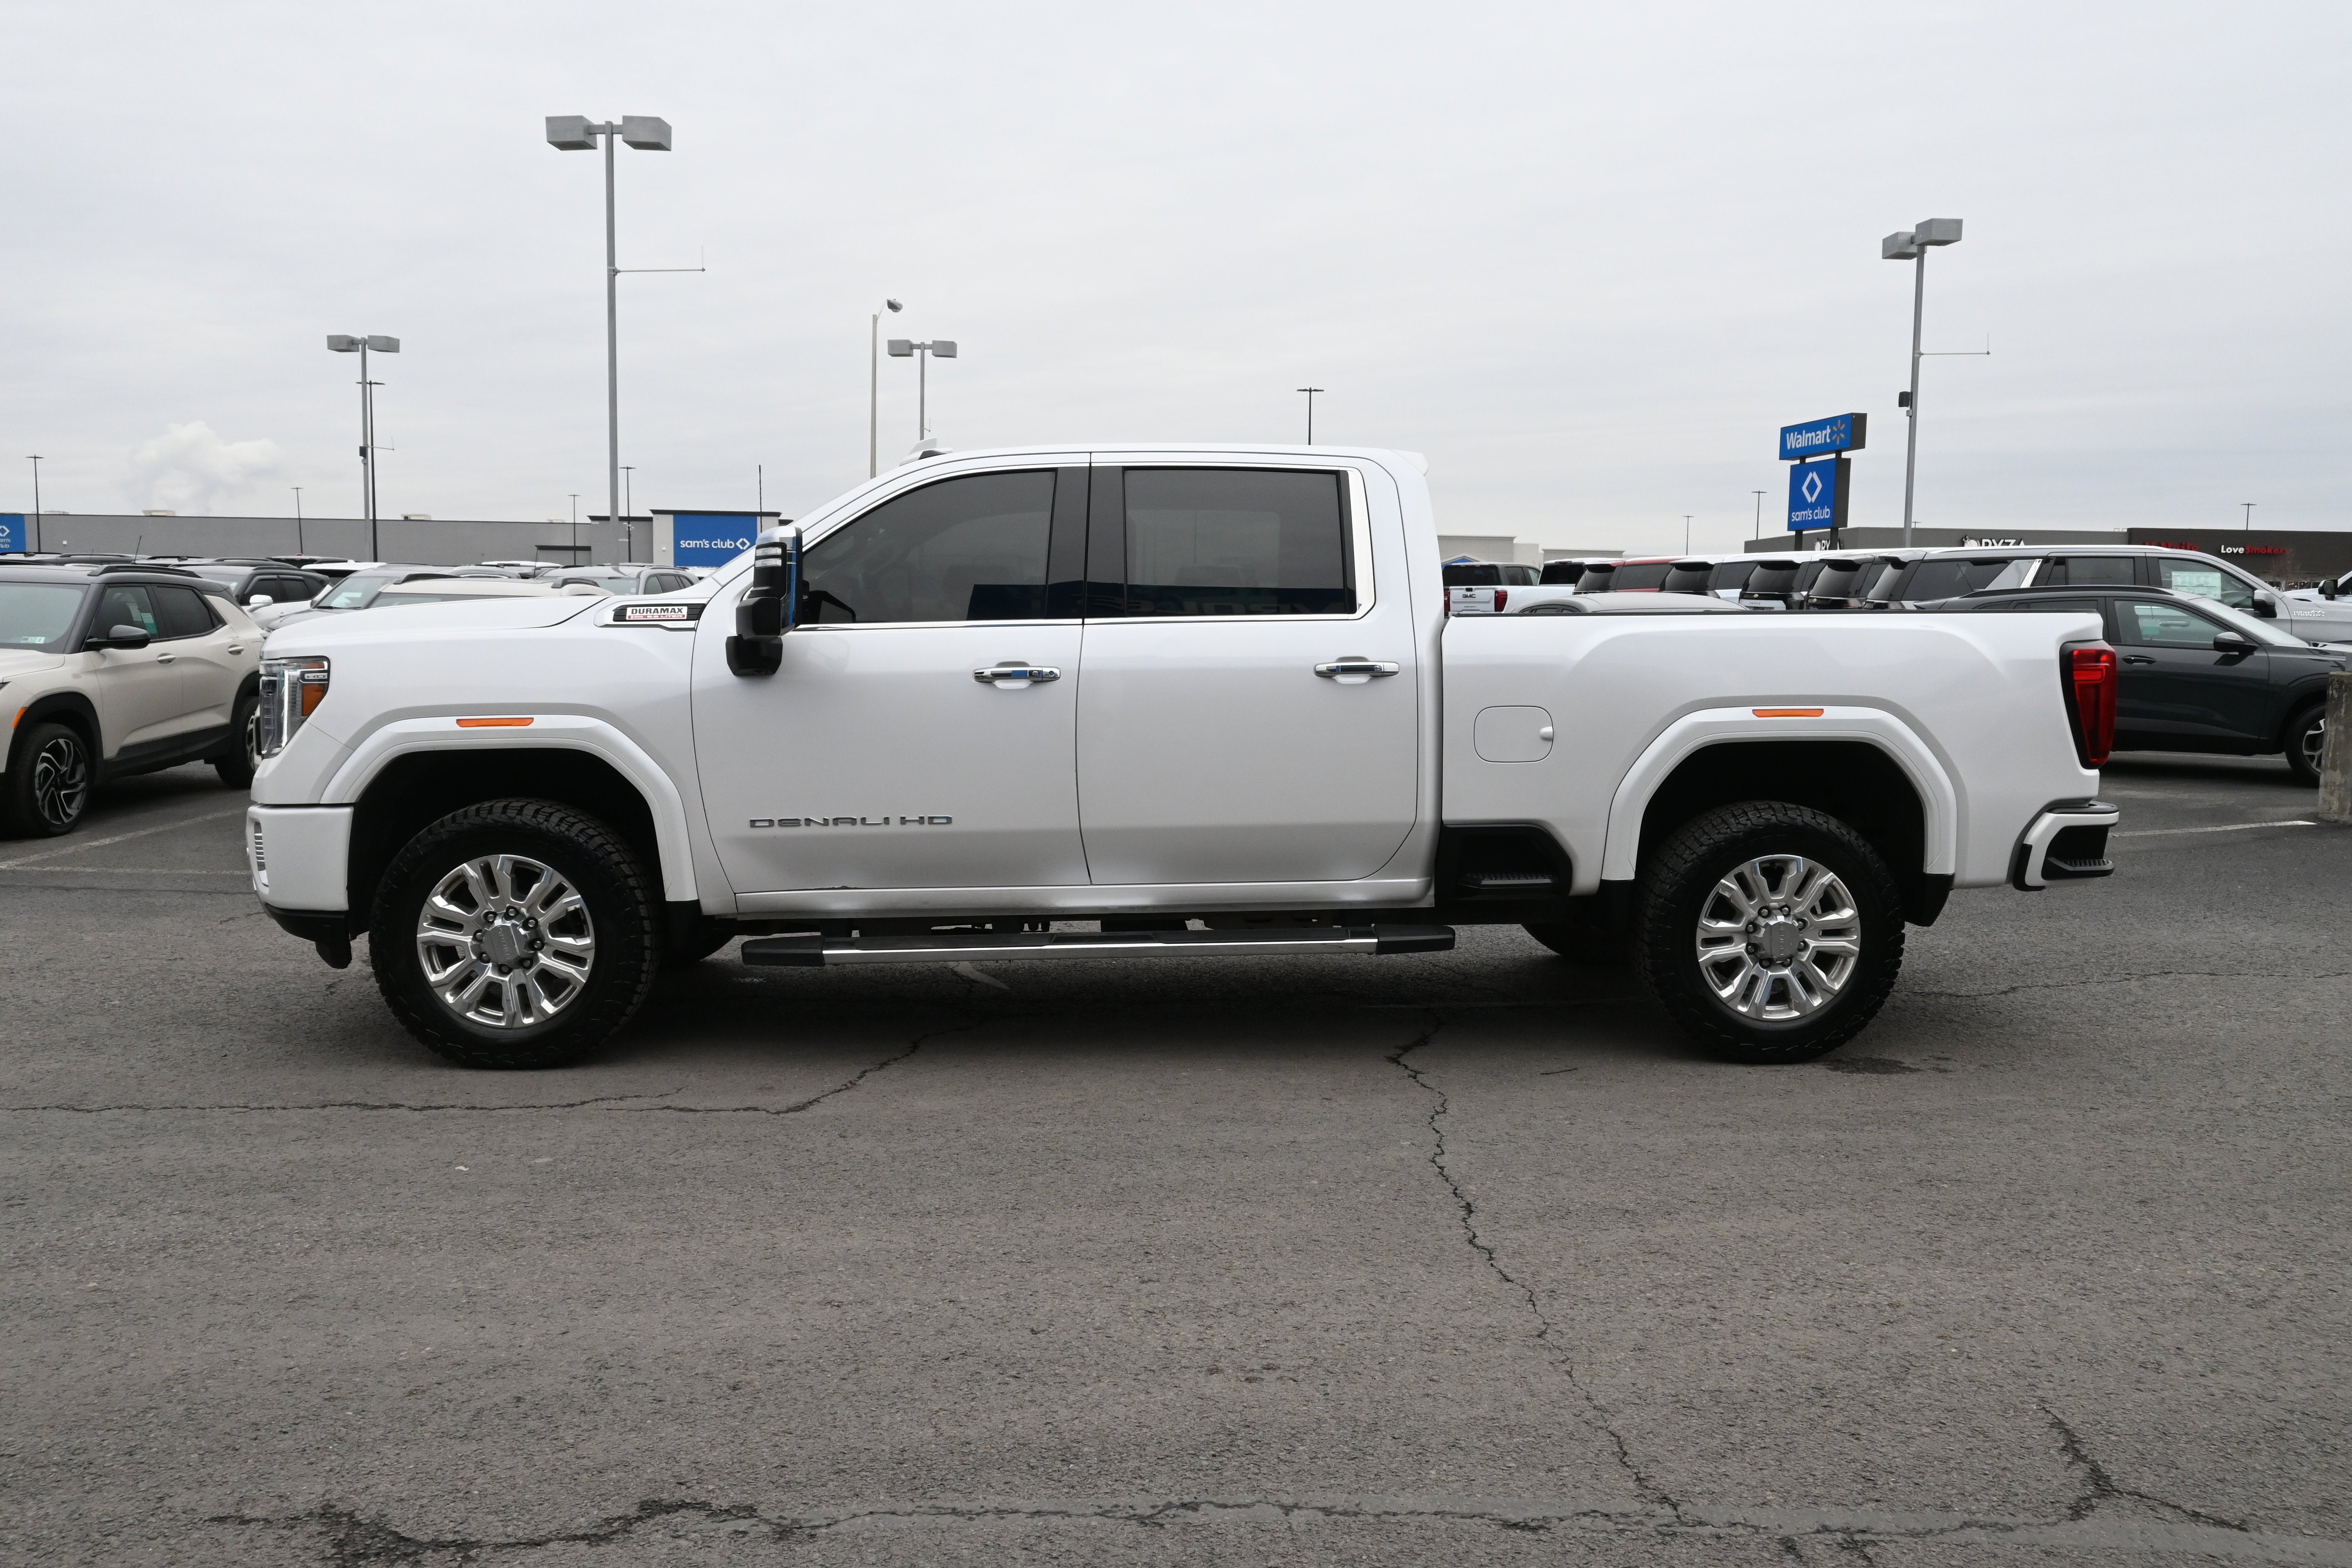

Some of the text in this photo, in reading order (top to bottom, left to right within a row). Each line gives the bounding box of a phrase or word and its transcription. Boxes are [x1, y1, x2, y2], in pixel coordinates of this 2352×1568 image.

[1786, 425, 1831, 449] Walmart
[1791, 505, 1830, 521] sam's club
[680, 539, 735, 548] sam's club
[750, 815, 952, 828] DENALI HD
